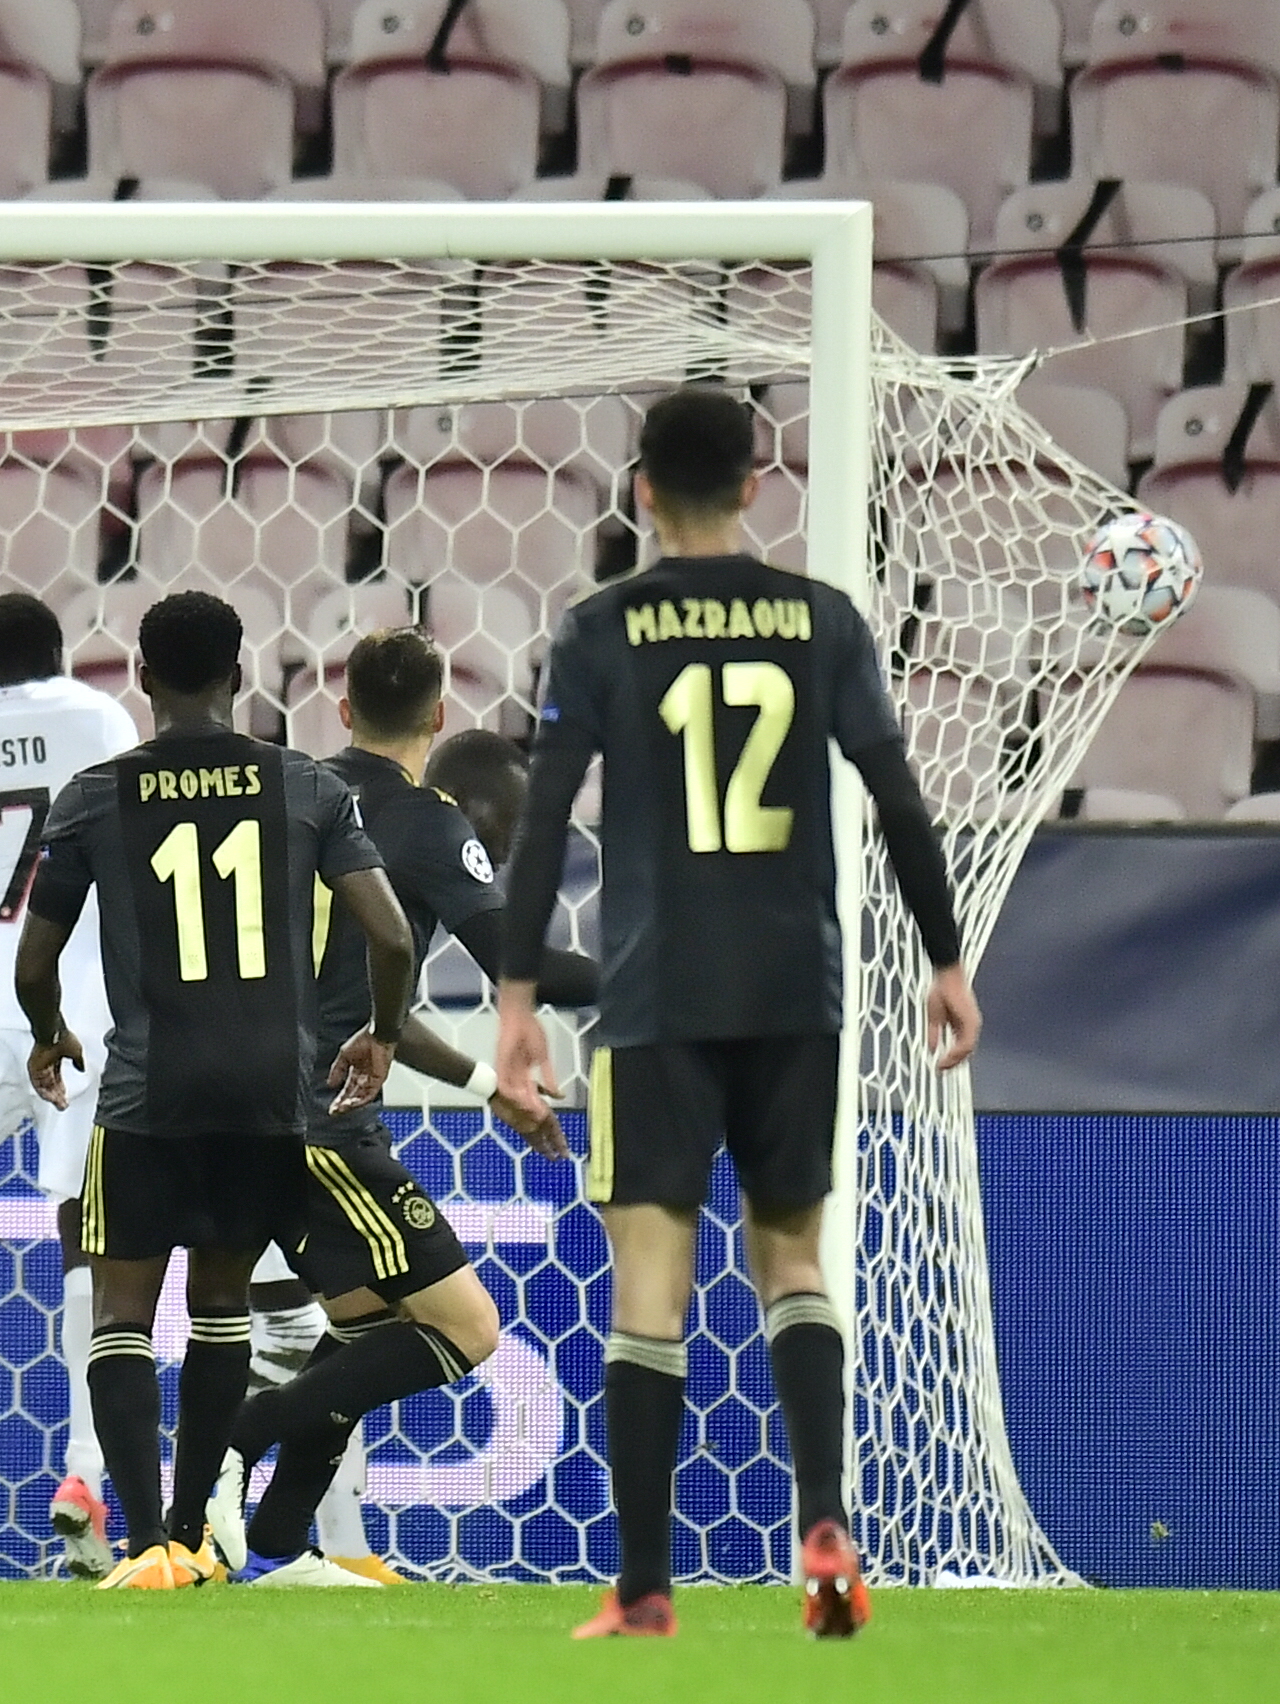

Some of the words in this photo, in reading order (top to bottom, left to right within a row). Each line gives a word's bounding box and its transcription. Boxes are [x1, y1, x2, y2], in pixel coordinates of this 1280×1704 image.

[625, 598, 812, 646] MAZRAOUI
[139, 764, 263, 802] PROMES
[658, 662, 795, 852] 12
[150, 819, 266, 981] 11
